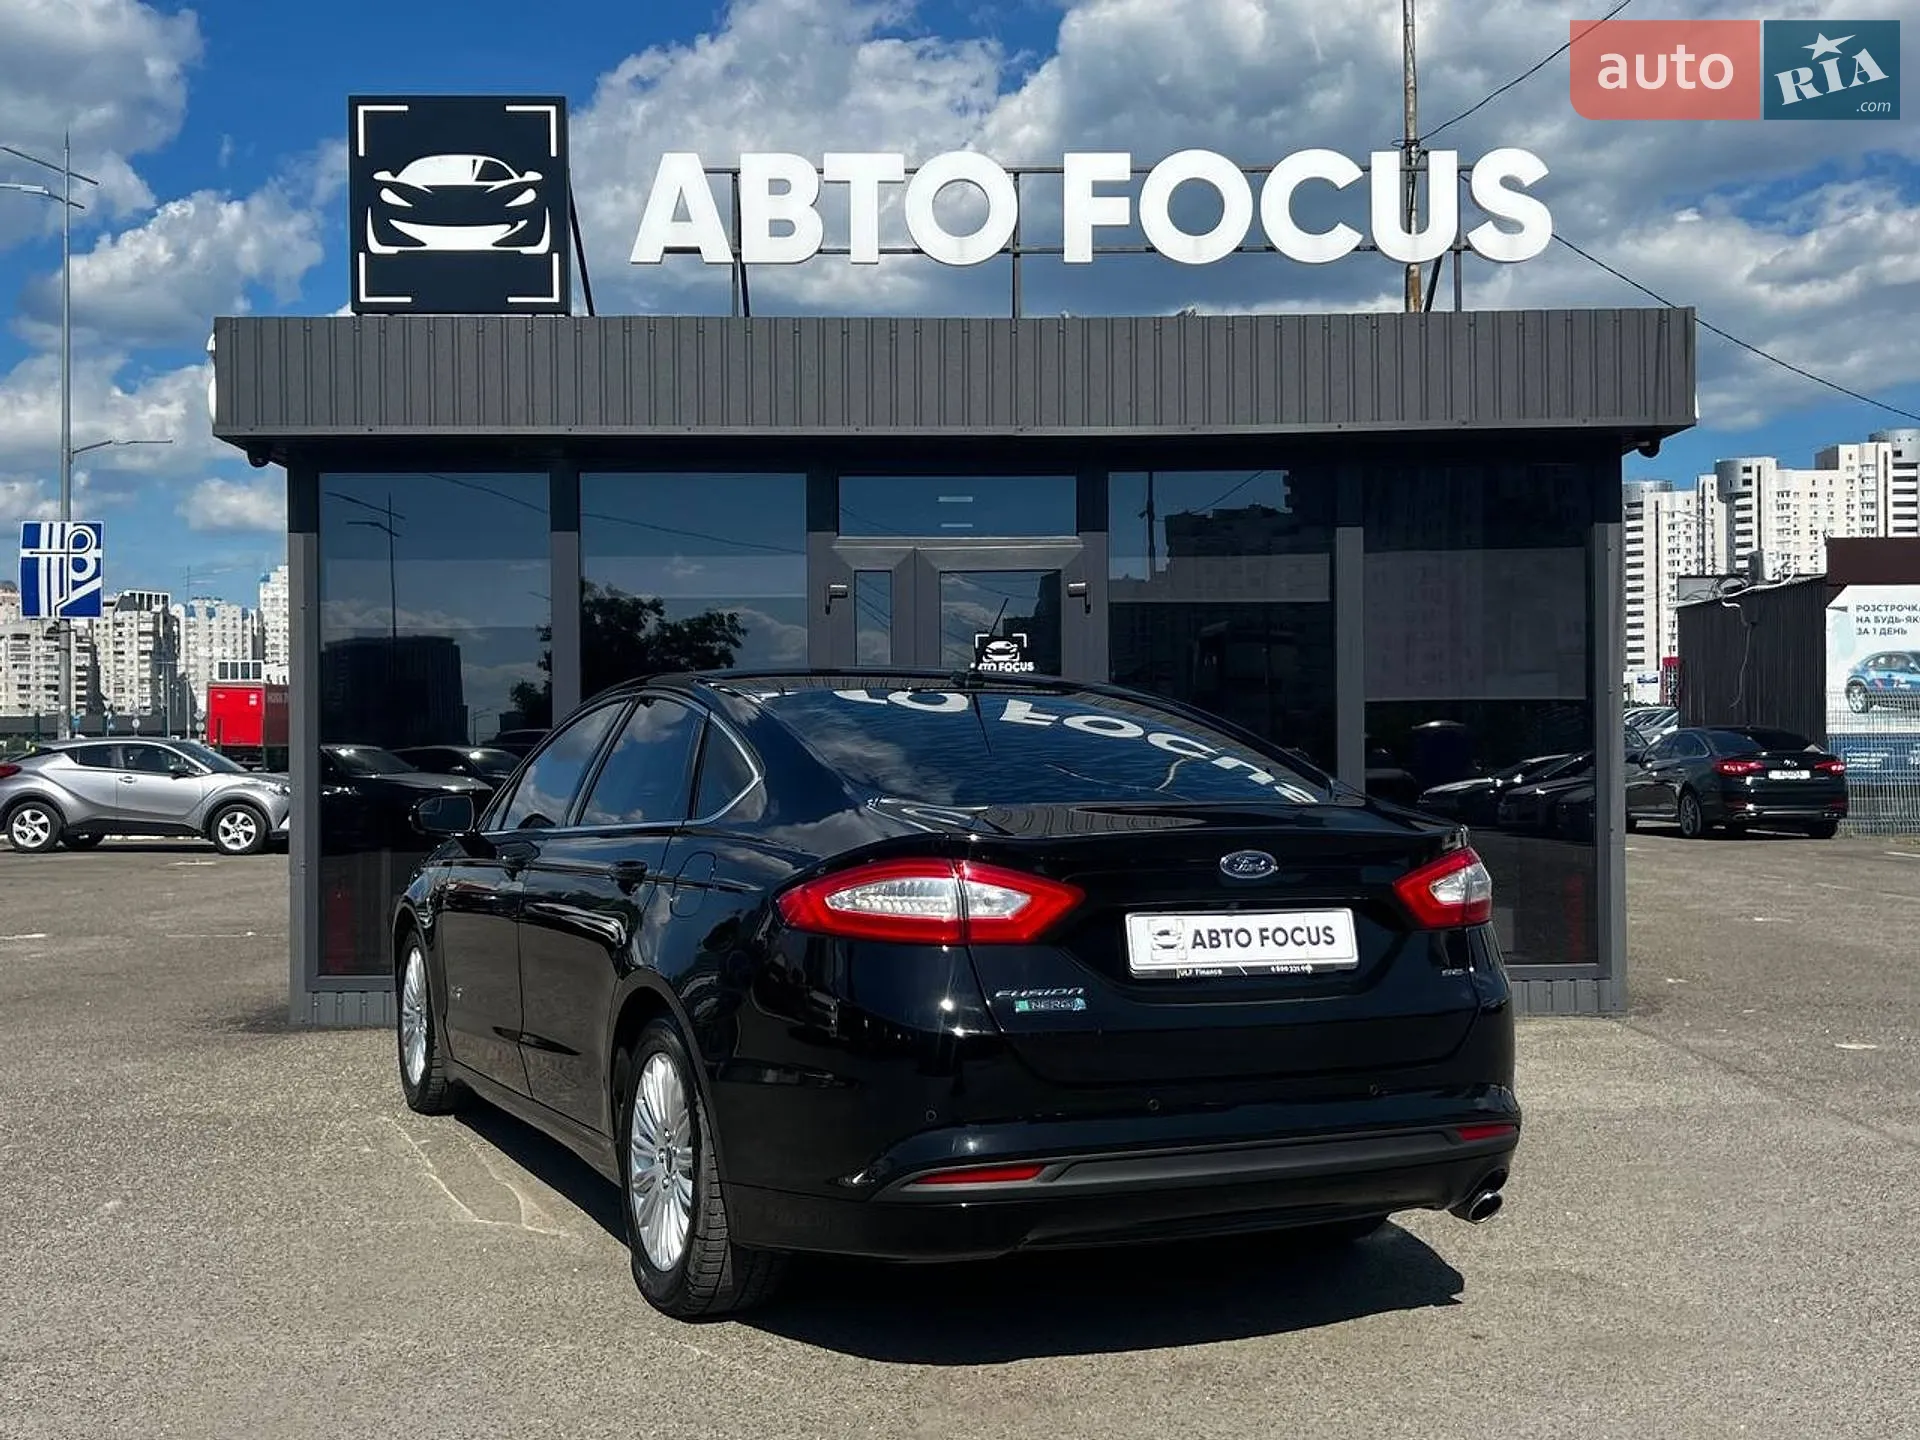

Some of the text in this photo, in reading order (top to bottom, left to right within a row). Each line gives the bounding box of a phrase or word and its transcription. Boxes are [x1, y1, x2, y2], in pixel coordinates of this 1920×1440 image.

[629, 148, 1553, 265] АВТО FOCUS
[1856, 604, 1920, 612] РОЗСТРОЧК
[998, 661, 1034, 672] FOCUS
[1191, 925, 1335, 949] АВТО FOCUS
